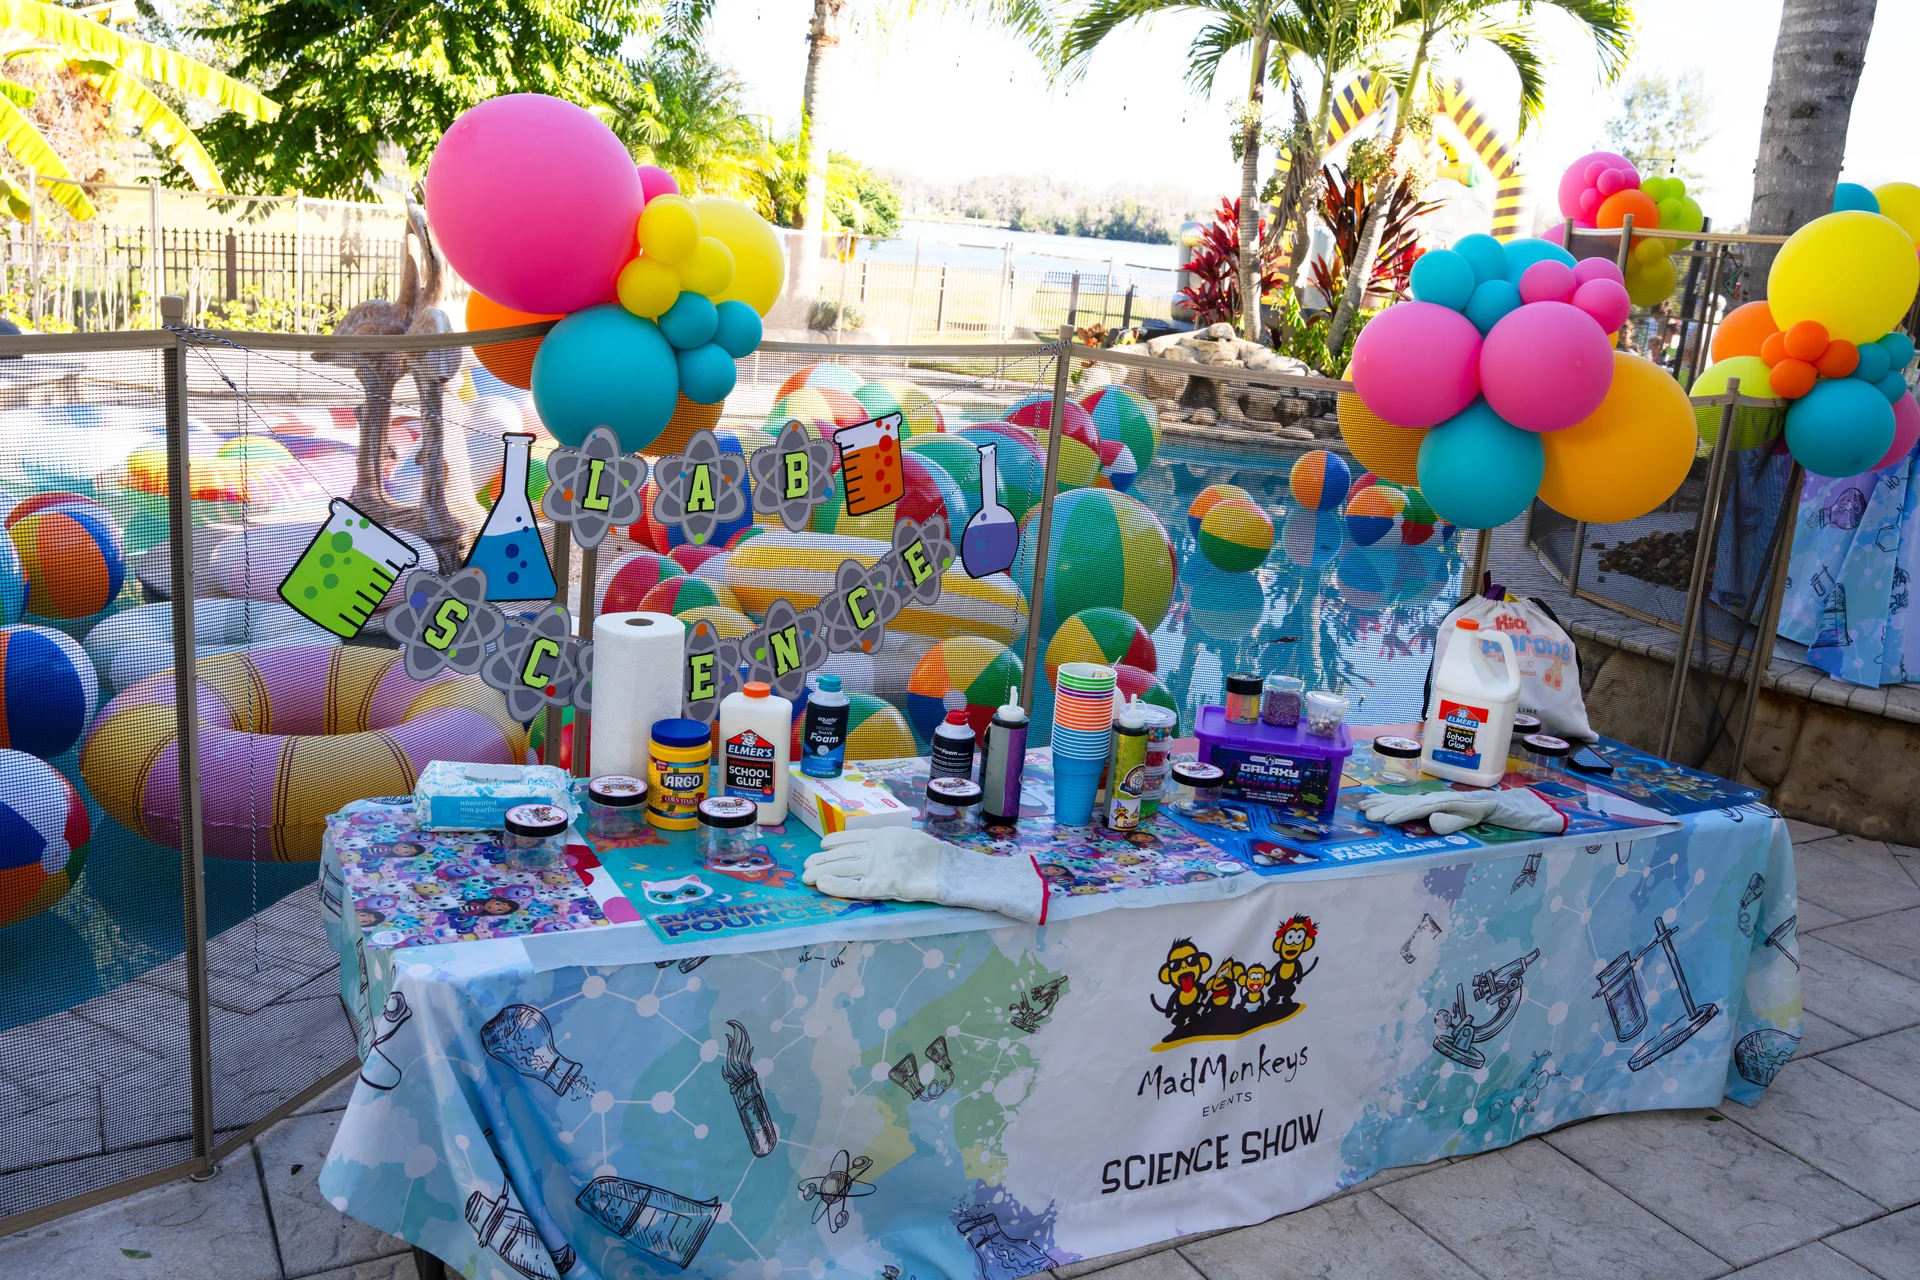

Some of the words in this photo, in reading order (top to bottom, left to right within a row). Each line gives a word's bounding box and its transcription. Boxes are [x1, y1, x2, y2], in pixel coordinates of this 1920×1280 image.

[1448, 715, 1477, 727] ELMER'S
[810, 732, 839, 744] Foam
[1446, 731, 1473, 744] School
[728, 744, 773, 757] ELMER'S
[1447, 739, 1466, 750] Glue
[728, 765, 771, 778] SCHOOL
[1240, 763, 1299, 778] GALAXY
[664, 774, 700, 788] ARGO
[735, 776, 762, 787] GLUE
[664, 795, 680, 803] CORN
[1331, 847, 1387, 861] FAST
[1388, 840, 1446, 854] LANE
[1202, 1091, 1253, 1118] EVENTS
[1101, 1134, 1229, 1195] SCIENCE
[1241, 1108, 1324, 1165] SHOW
